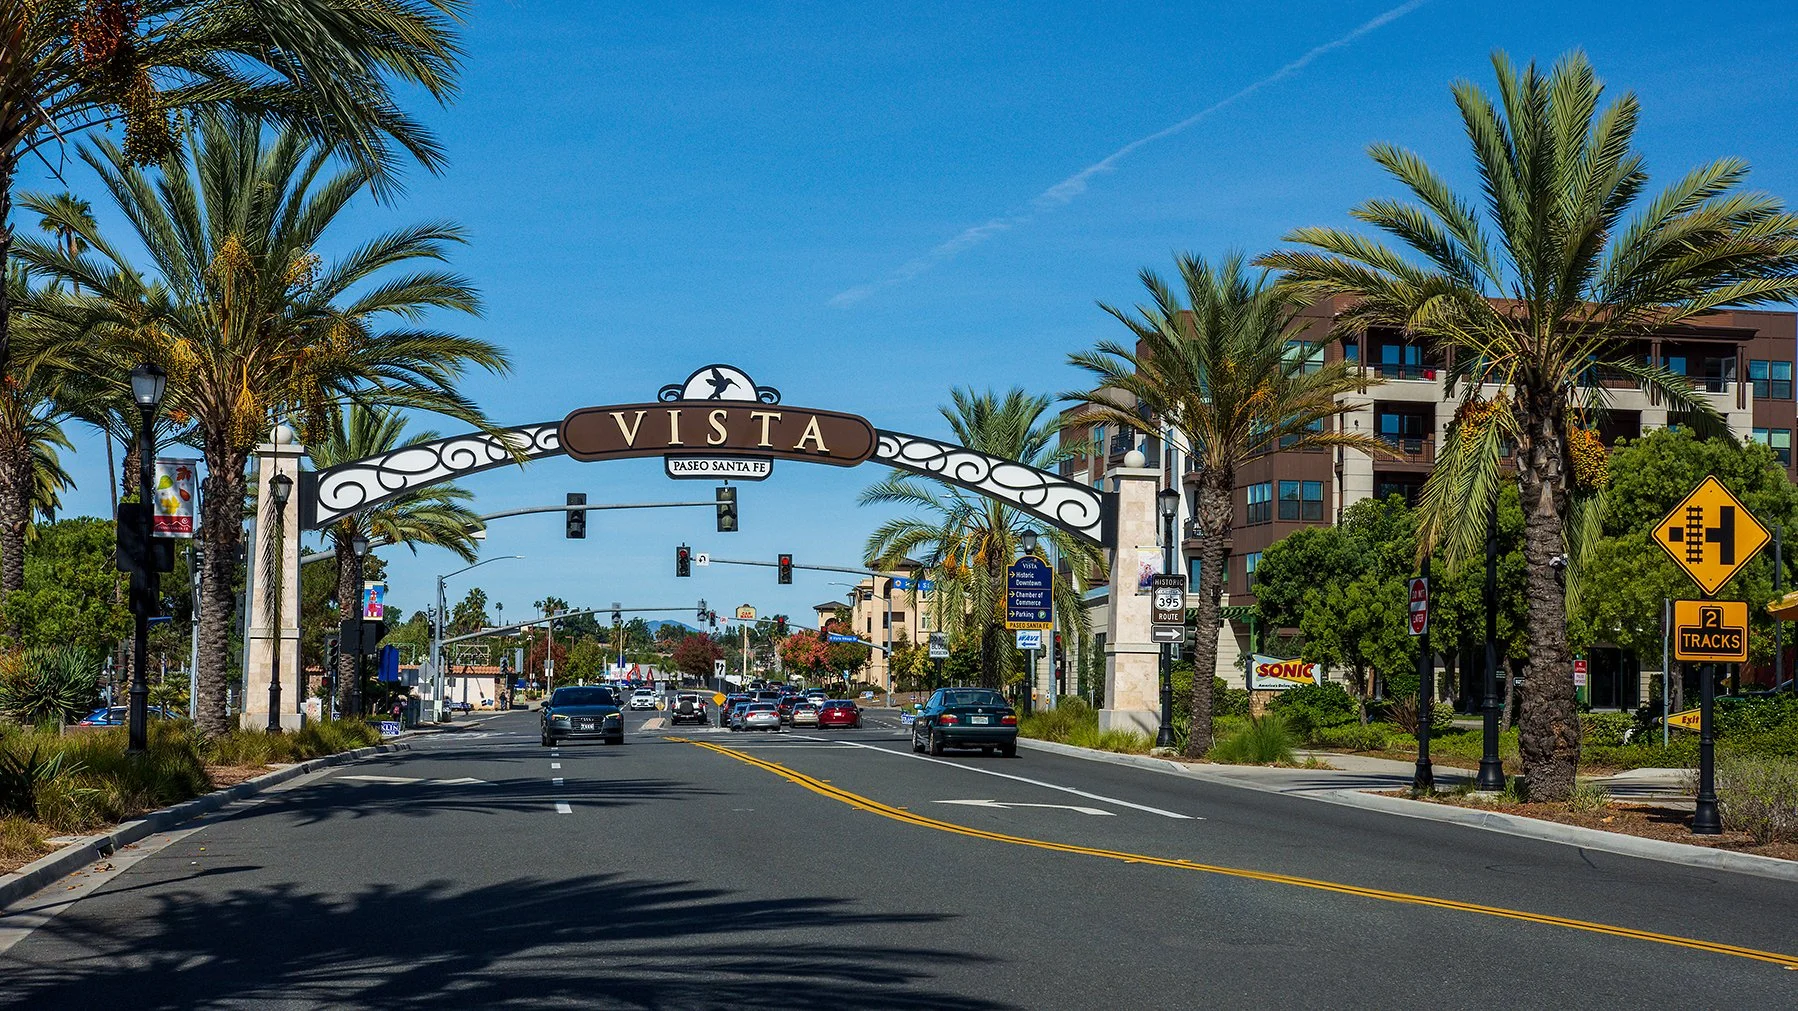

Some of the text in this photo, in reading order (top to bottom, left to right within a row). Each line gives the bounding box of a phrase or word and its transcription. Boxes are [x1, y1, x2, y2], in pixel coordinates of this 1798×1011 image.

[608, 408, 831, 453] VISTA
[673, 460, 766, 473] PASEO SANTA FE
[1015, 571, 1035, 579] Historic
[1154, 578, 1184, 586] HISTORIC
[1015, 590, 1044, 599] Chamber of
[1411, 590, 1418, 600] DO
[1015, 598, 1042, 606] Commerce
[1158, 597, 1180, 608] 395
[1015, 610, 1035, 619] Parking
[1158, 613, 1179, 621] ROUTE
[1412, 613, 1424, 624] ENTER
[1705, 610, 1718, 628] 2
[1682, 632, 1741, 649] TRACKS
[1257, 662, 1316, 678] SONIC
[1681, 714, 1700, 727] Exit
